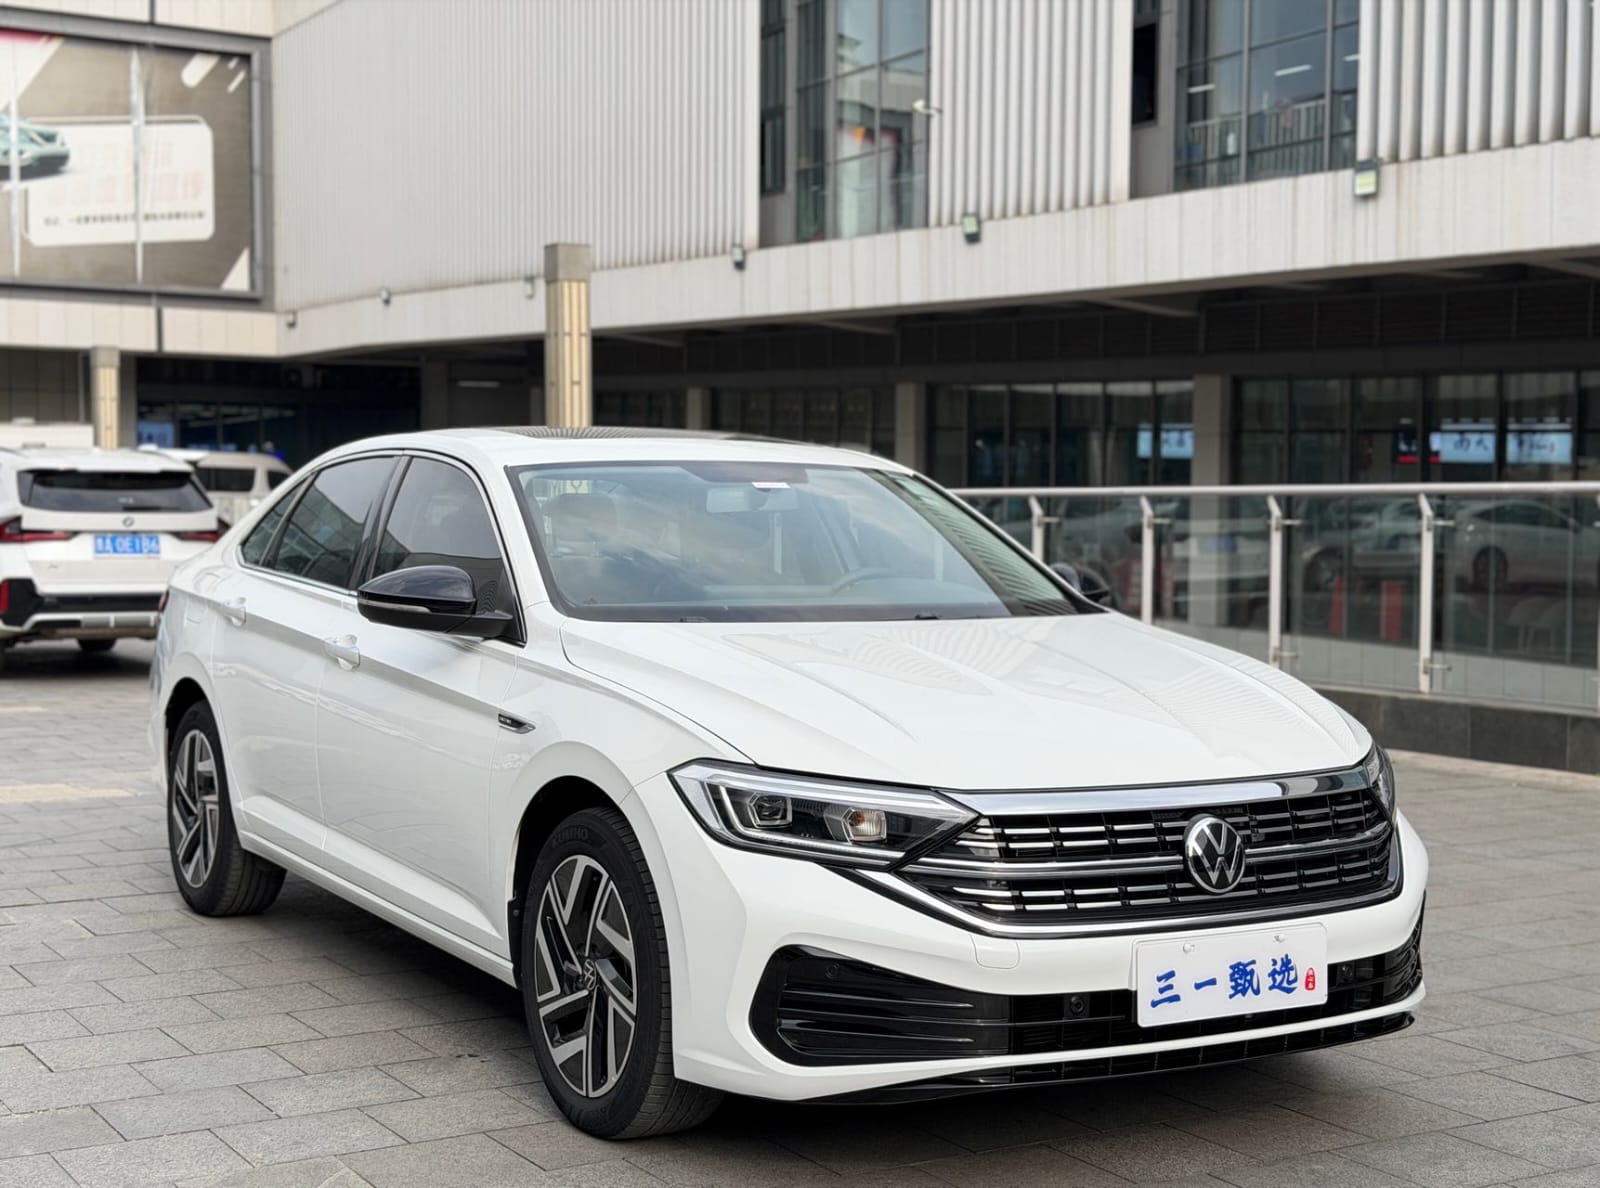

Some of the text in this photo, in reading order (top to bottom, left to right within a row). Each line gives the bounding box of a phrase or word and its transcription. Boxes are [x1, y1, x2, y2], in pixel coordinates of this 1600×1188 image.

[1187, 817, 1245, 893] VW
[1151, 954, 1298, 1008] 三一甄选
